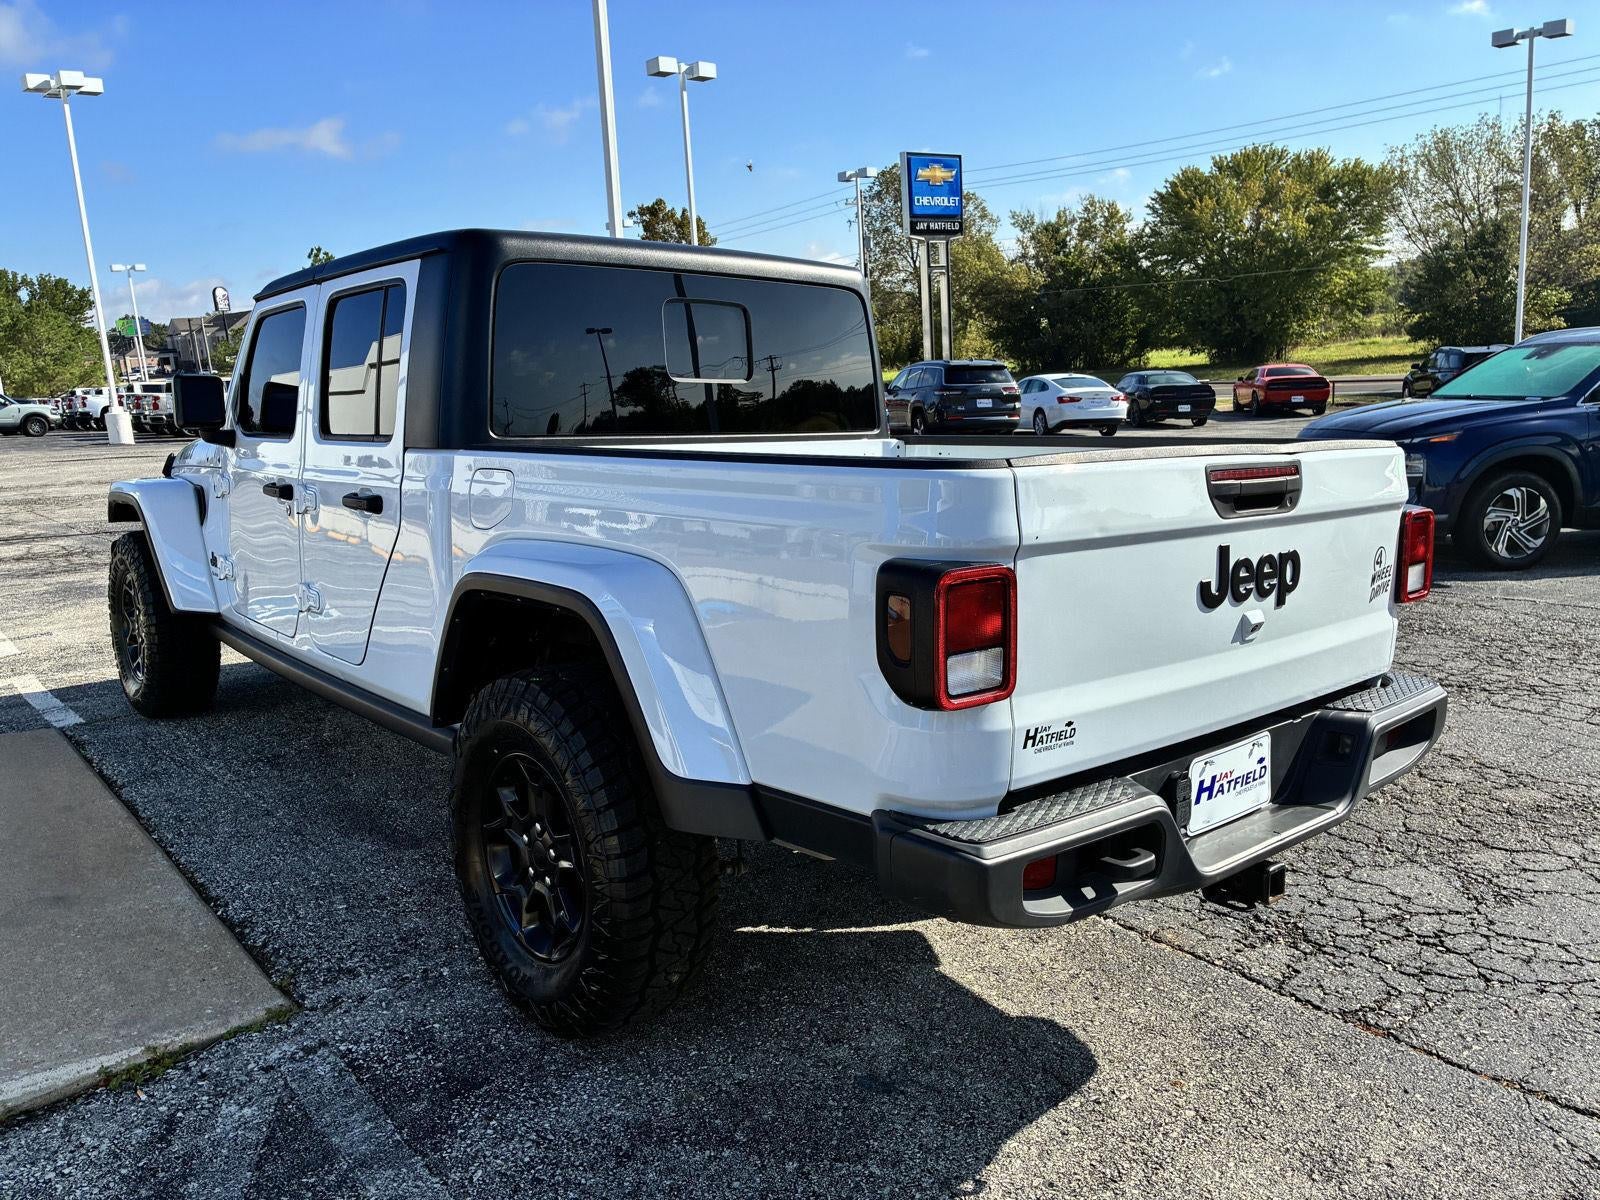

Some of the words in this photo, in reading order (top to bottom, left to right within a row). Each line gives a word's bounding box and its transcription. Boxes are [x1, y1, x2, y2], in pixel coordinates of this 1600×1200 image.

[914, 196, 960, 207] CHEVROLET
[916, 222, 928, 231] JAY
[929, 222, 960, 231] HATFIELD
[1200, 543, 1301, 610] Jeep
[1370, 565, 1392, 587] WHEEL
[1369, 579, 1390, 603] DRIVE
[1022, 727, 1076, 750] HATFIELD
[1038, 725, 1052, 734] JAY
[1194, 765, 1267, 806] HATFIELD
[1216, 769, 1235, 783] JAY
